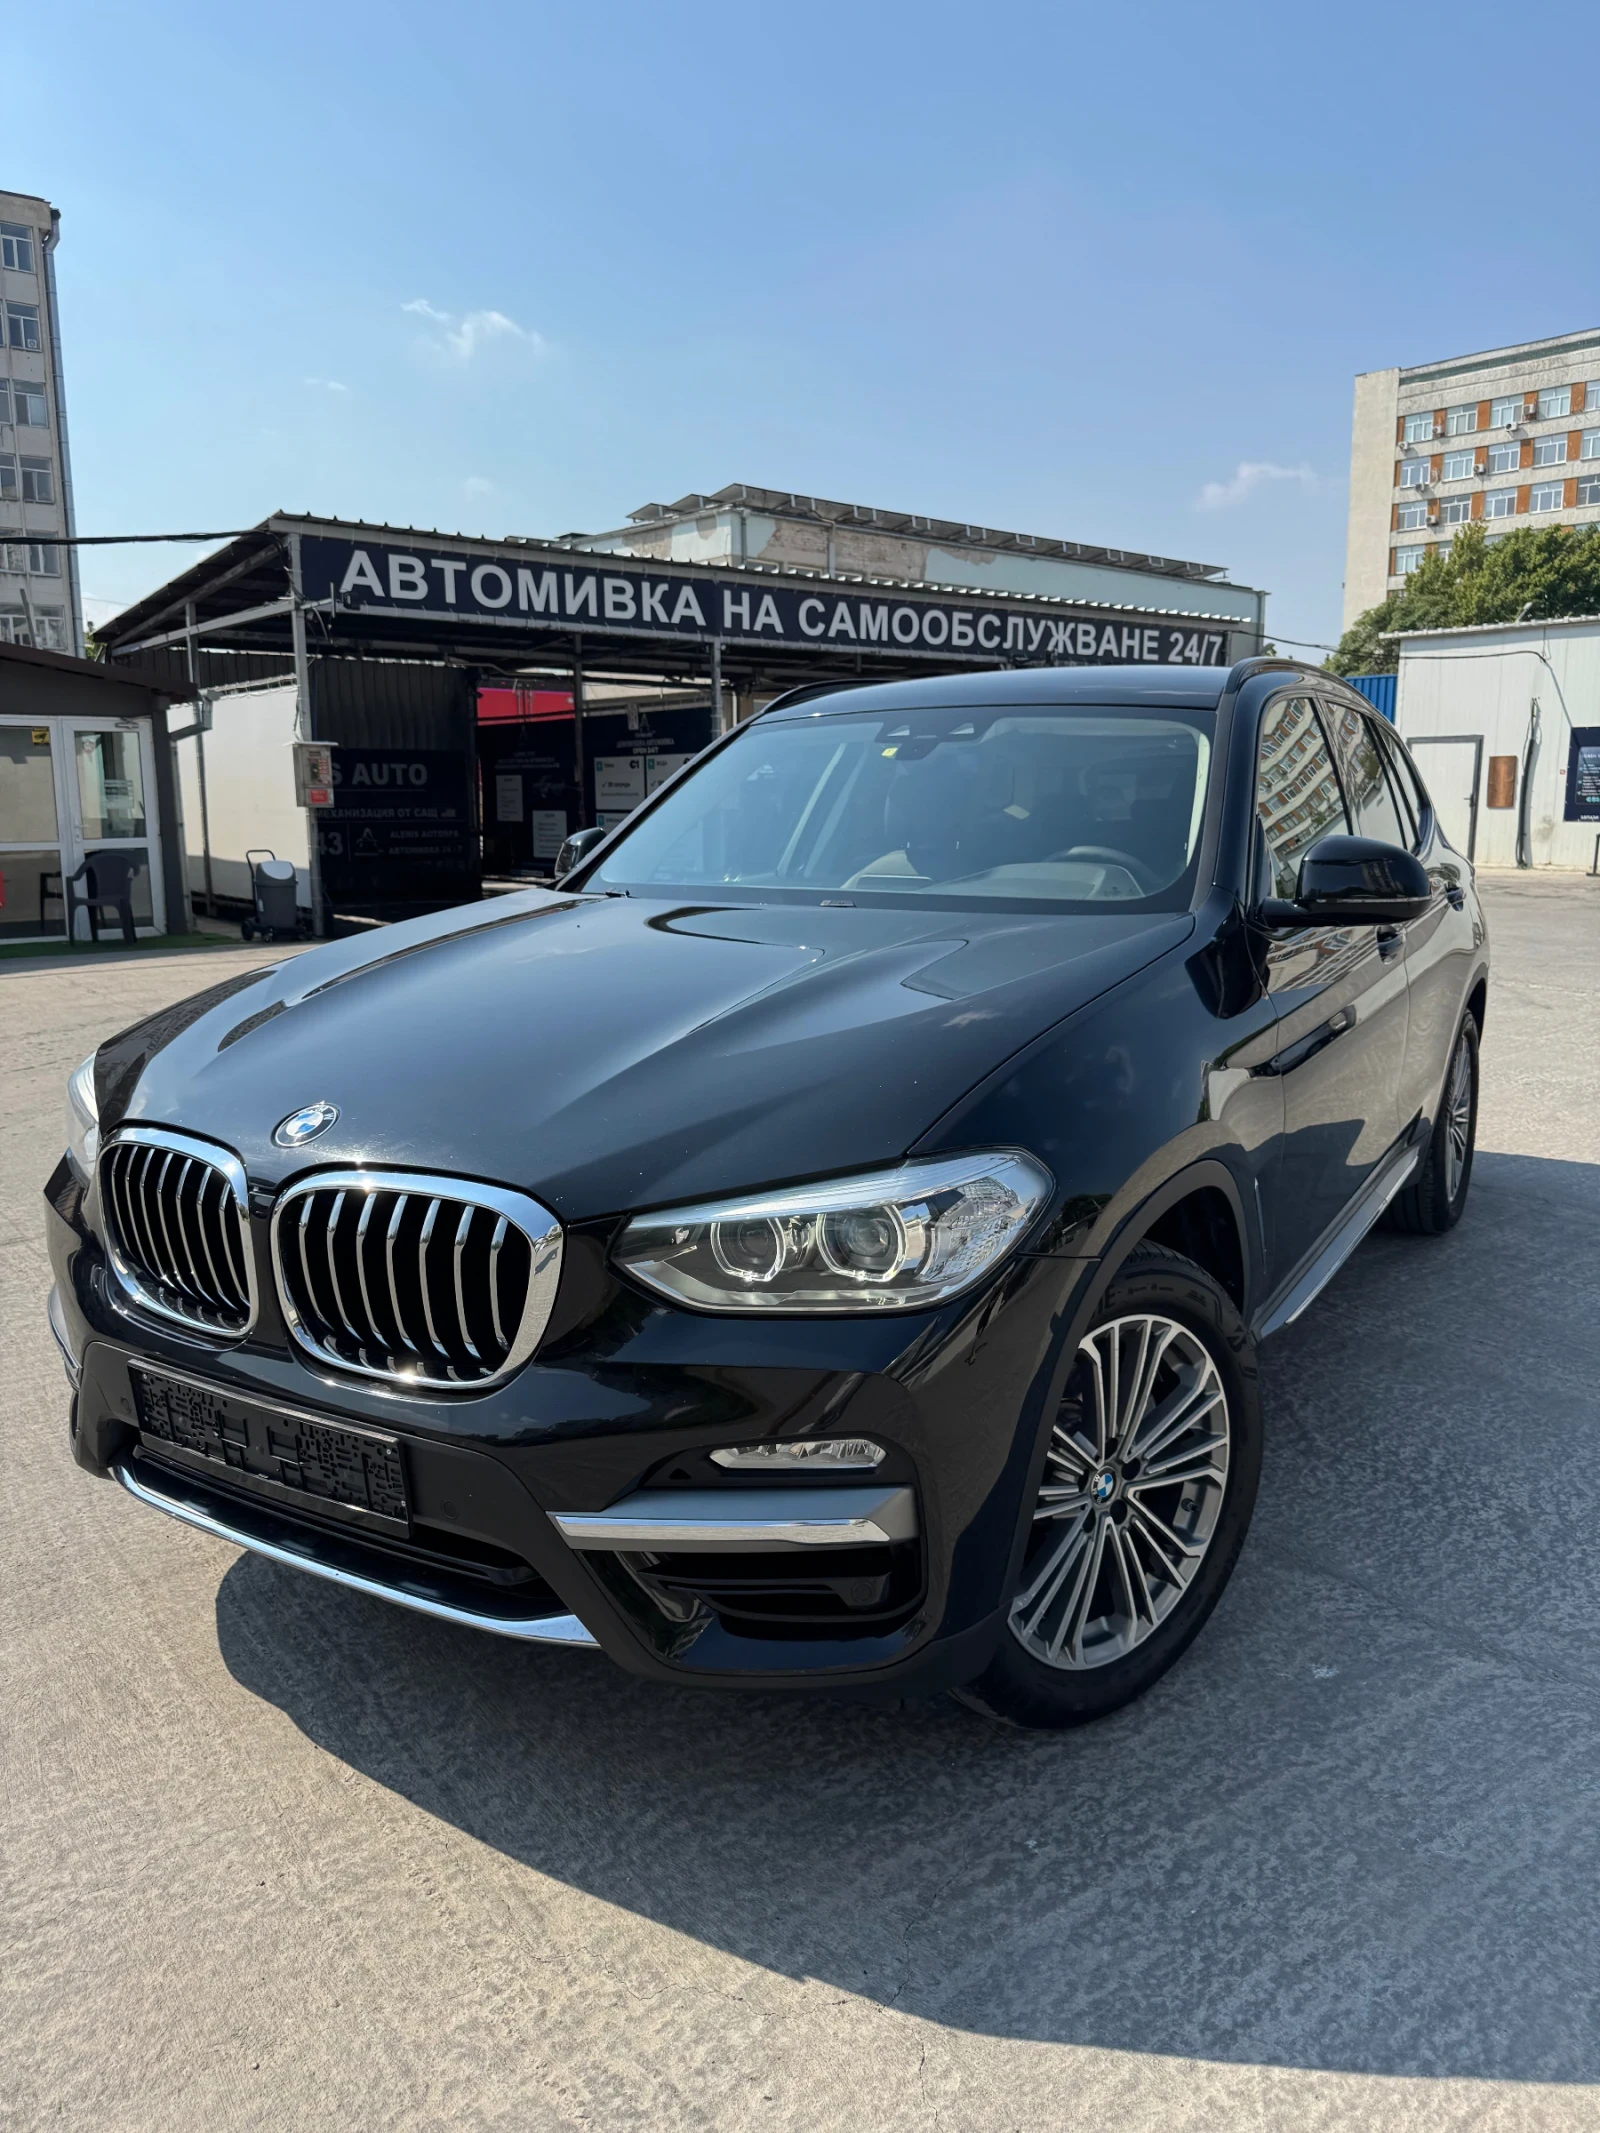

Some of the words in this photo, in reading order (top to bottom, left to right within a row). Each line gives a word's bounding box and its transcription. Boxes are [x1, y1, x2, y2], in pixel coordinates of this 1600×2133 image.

[339, 550, 706, 627] АВТОМИВКА
[723, 589, 784, 634] НА
[798, 598, 1160, 662] САМООБСЛУЖВАНЕ
[1168, 631, 1225, 666] 24/7
[352, 762, 428, 786] AUTO
[397, 808, 411, 818] ОТ
[414, 807, 438, 820] САЩ
